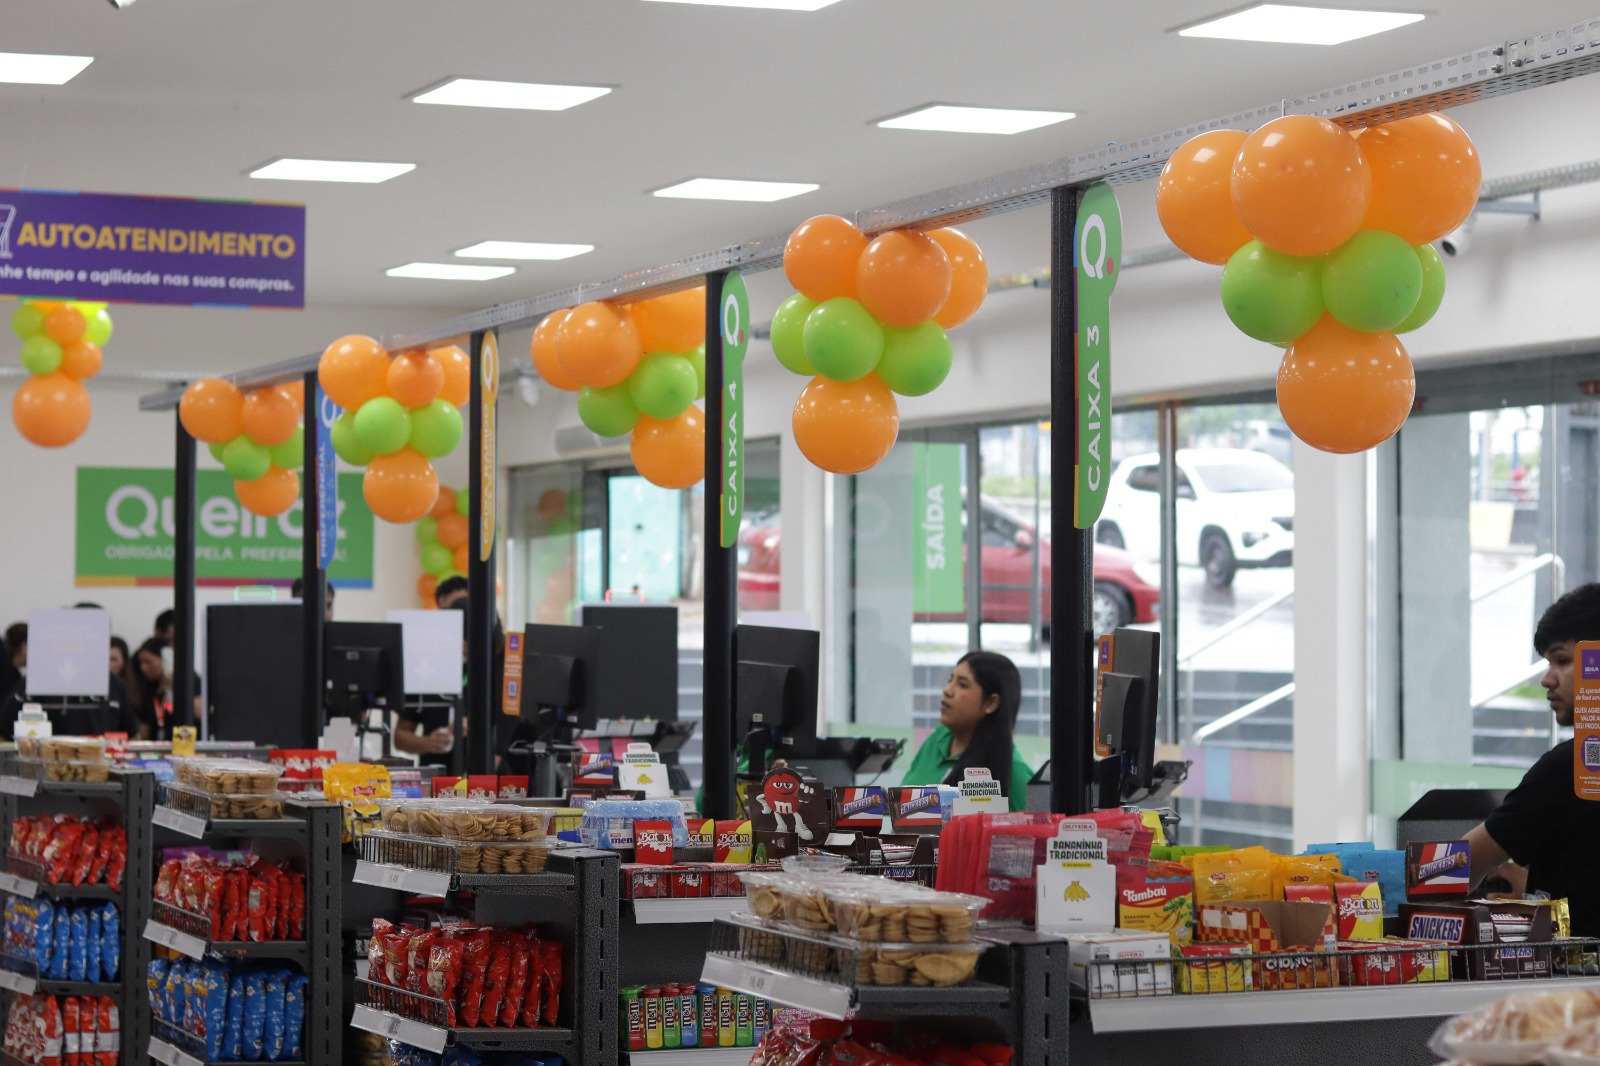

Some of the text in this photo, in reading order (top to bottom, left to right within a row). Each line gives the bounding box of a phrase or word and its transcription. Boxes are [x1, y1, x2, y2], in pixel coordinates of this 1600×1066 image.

[17, 222, 296, 259] AUTOATENDIMENTO
[26, 266, 75, 284] tempo
[77, 271, 88, 282] e
[90, 268, 160, 286] agilidade
[163, 274, 190, 286] nas
[192, 276, 226, 288] suas
[229, 278, 295, 293] compras.
[1086, 324, 1101, 492] CAIXA 3
[728, 380, 738, 517] CAIXA 4
[921, 482, 945, 570] SAÍDA
[105, 544, 176, 560] OBRIGAD
[843, 796, 872, 814] SNICKERS
[900, 796, 929, 814] SNICKERS
[639, 832, 671, 843] Baton
[720, 833, 751, 844] Baton
[1049, 850, 1106, 860] TRADICIONAL
[1419, 856, 1455, 878] SNICKERS
[1122, 885, 1167, 903] Tambaú
[1342, 897, 1380, 913] Baton
[1410, 916, 1462, 940] SNICKERS
[1112, 967, 1150, 977] TADICINAL
